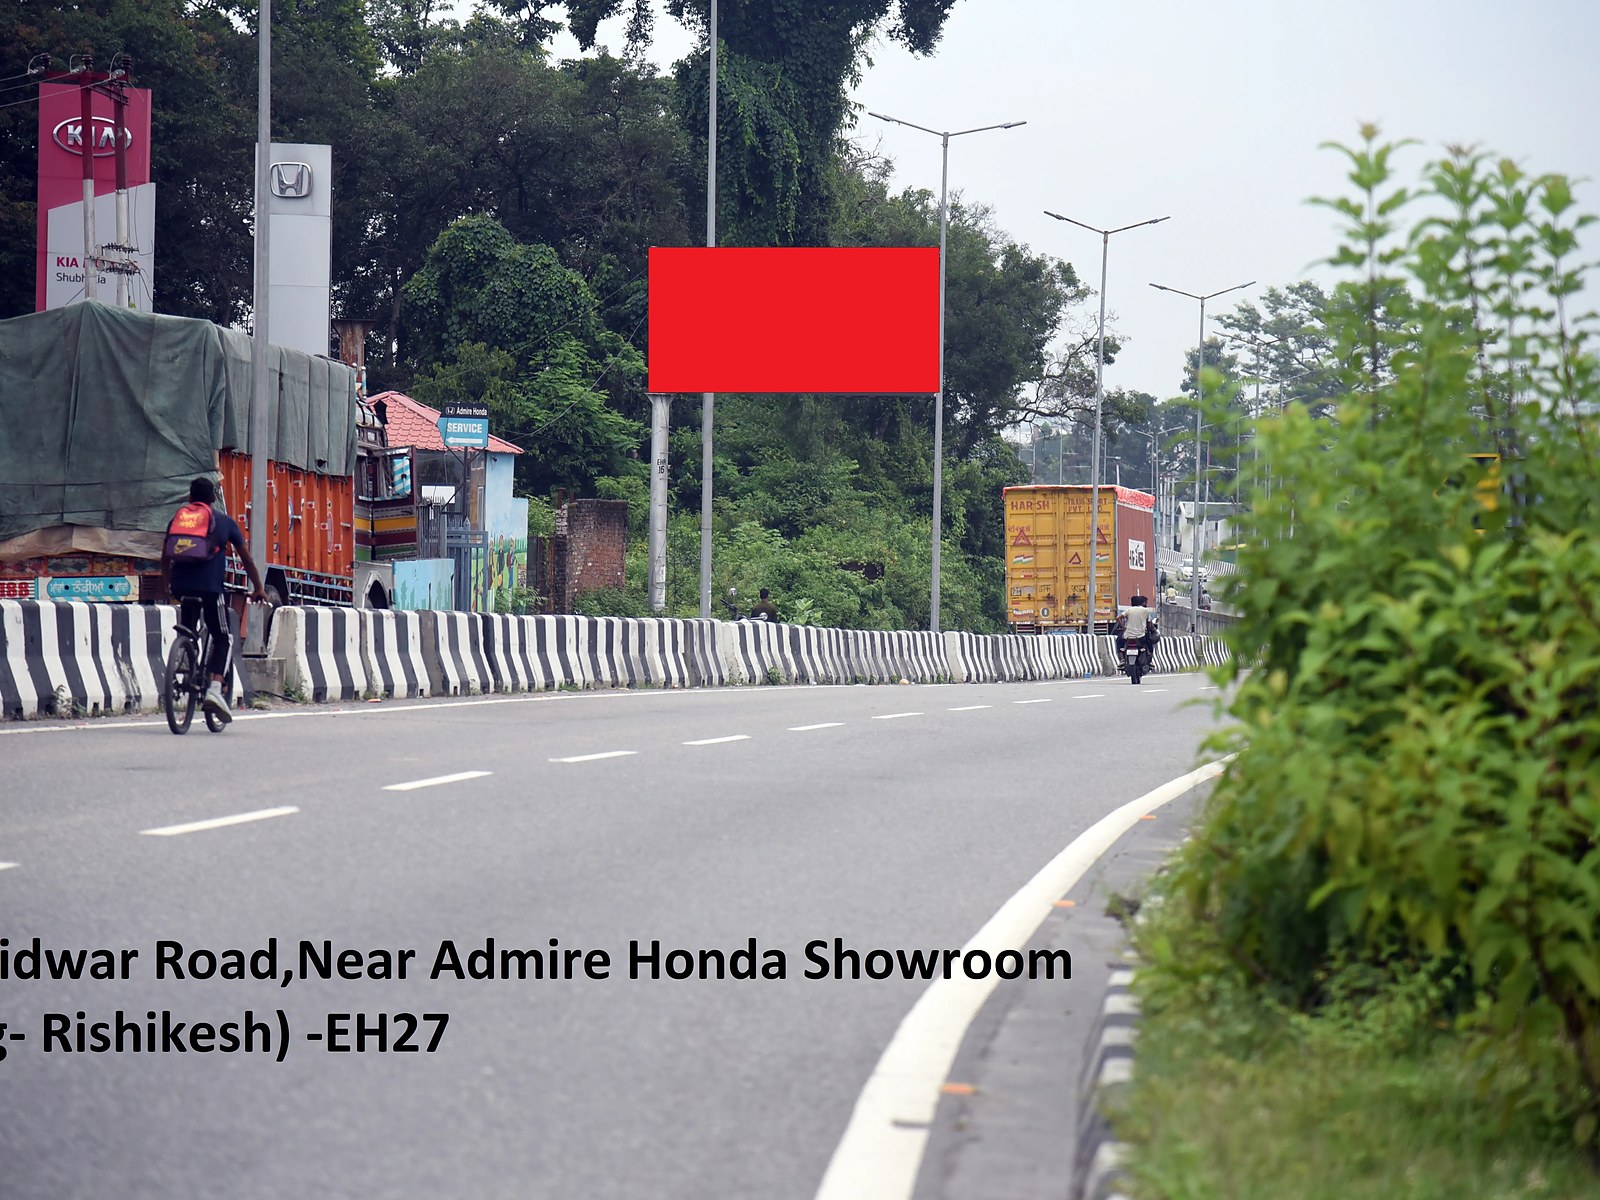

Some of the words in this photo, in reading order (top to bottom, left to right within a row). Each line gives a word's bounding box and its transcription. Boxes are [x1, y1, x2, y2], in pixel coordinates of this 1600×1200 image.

[56, 256, 79, 268] KIA
[456, 406, 472, 415] Admire
[472, 407, 487, 416] Honda
[447, 422, 483, 433] SERVICE
[1011, 500, 1050, 511] HARSH
[1087, 505, 1103, 513] LD
